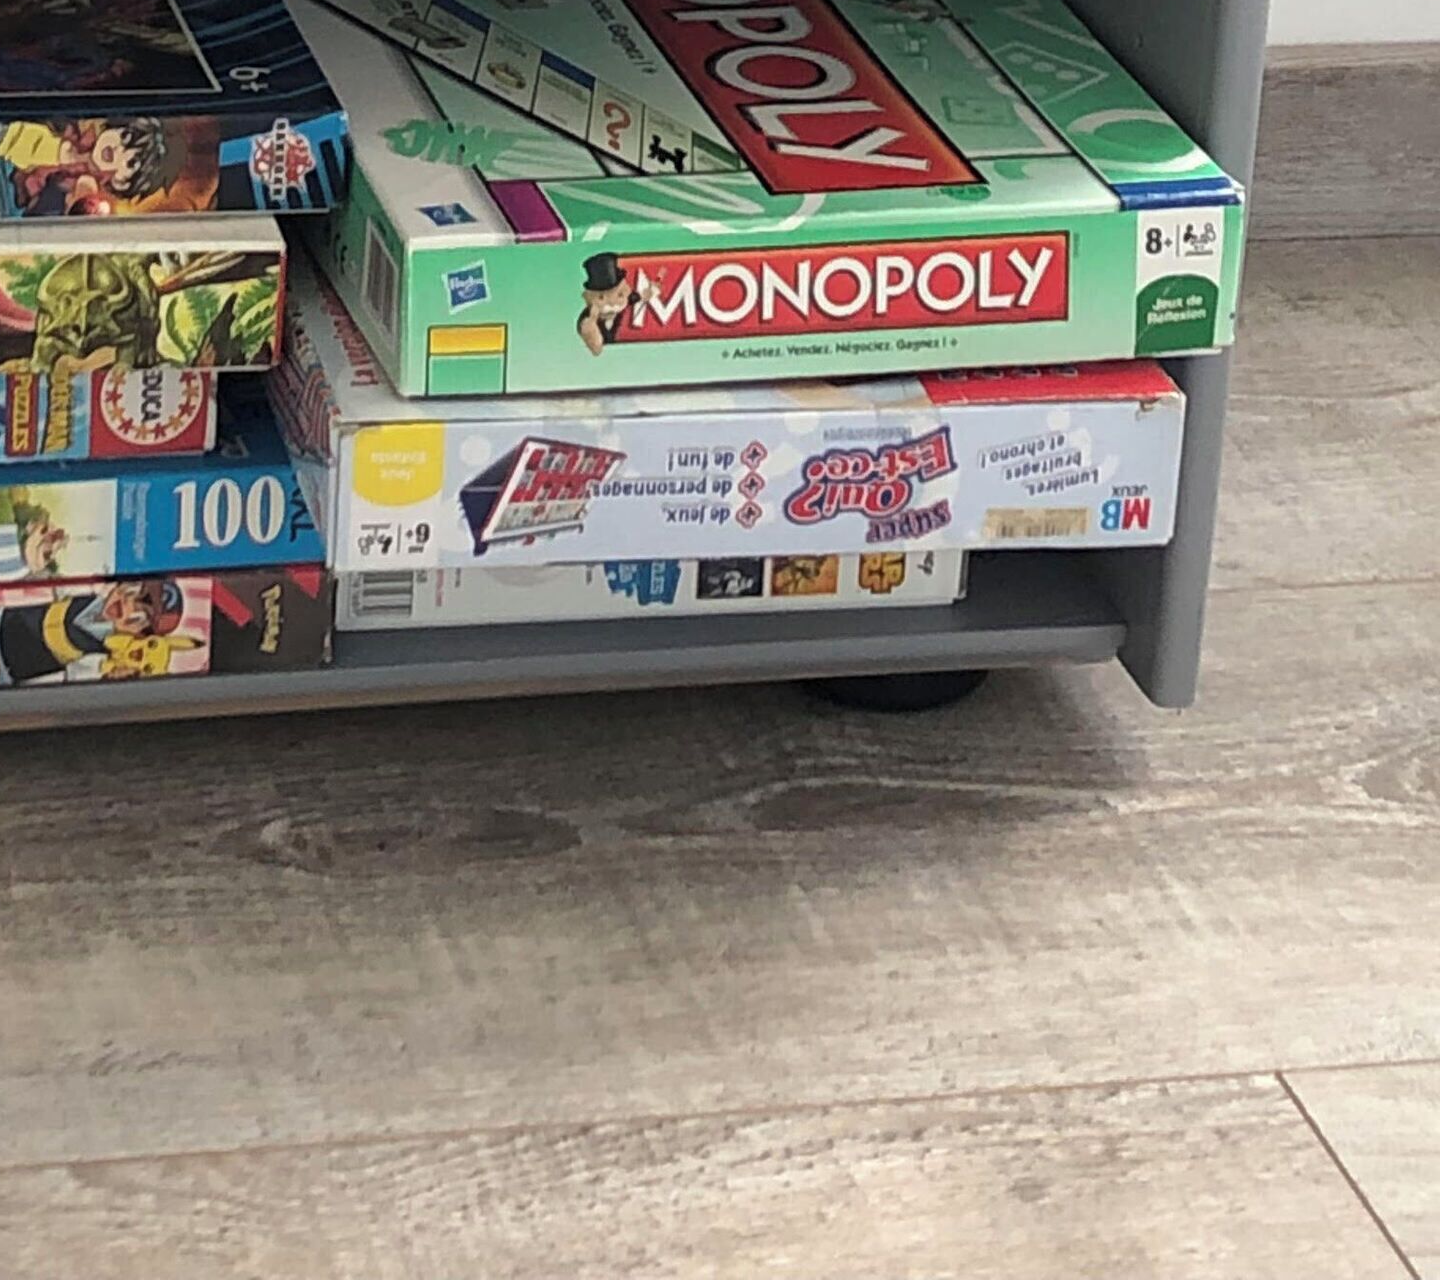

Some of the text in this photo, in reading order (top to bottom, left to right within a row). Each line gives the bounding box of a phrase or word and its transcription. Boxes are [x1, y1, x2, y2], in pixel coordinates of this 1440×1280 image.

[631, 244, 1054, 329] MONOPOLY
[1151, 294, 1204, 311] Jeux de
[13, 374, 32, 451] PUZZLES
[712, 451, 736, 472] de
[1004, 449, 1083, 482] bruitages
[710, 479, 733, 499] de
[1110, 485, 1149, 497] JEUX
[172, 474, 286, 550] 100
[708, 506, 732, 527] de
[1099, 494, 1152, 533] MB
